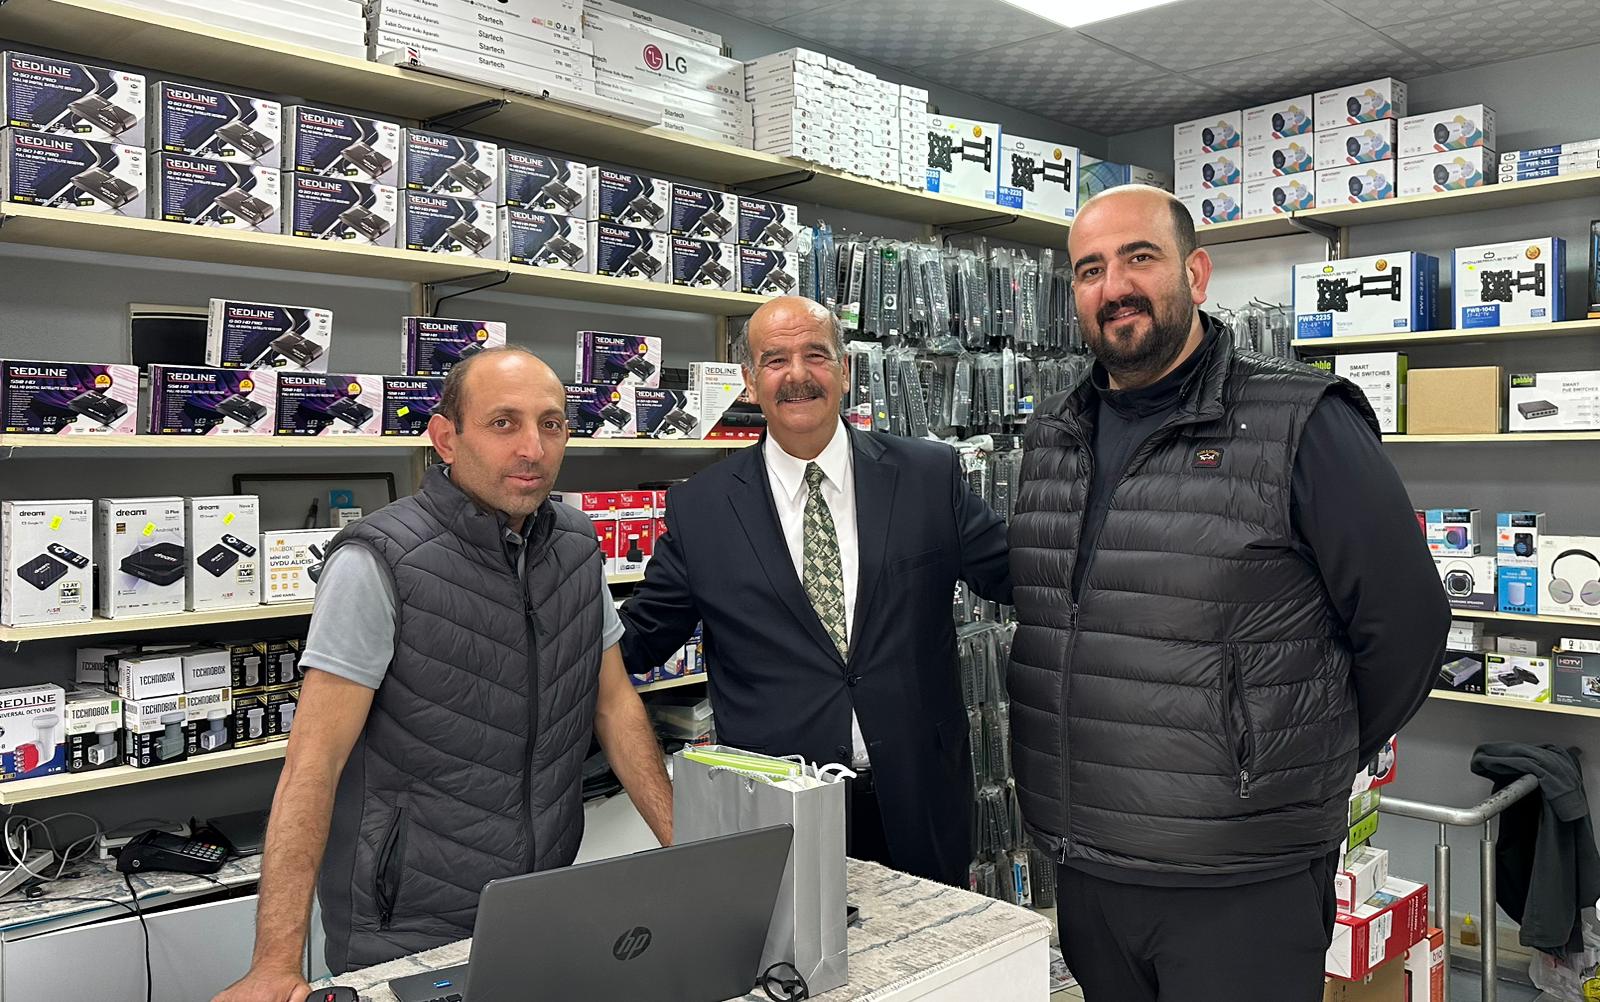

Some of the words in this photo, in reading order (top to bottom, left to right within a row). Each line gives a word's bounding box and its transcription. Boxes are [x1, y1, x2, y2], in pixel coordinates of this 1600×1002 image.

[478, 13, 504, 26] Startech
[632, 11, 653, 23] Startech
[479, 30, 504, 43] Startech
[479, 43, 505, 55] Startech
[12, 59, 71, 78] REDLINE
[479, 56, 505, 69] Startech
[665, 53, 688, 74] LG
[166, 88, 218, 106] REDLINE
[664, 108, 685, 119] Startech
[301, 113, 344, 129] REDLINE
[664, 121, 685, 132] Startech
[15, 134, 73, 152] REDLINE
[410, 133, 448, 148] REDLINE
[166, 158, 217, 175] REDLINE
[509, 153, 543, 168] REDLINE
[601, 171, 632, 183] REDLINE
[298, 179, 342, 193] REDLINE
[675, 189, 703, 200] REDLINE
[409, 194, 448, 208] REDLINE
[511, 210, 545, 223] REDLINE
[600, 226, 631, 238] REDLINE
[674, 238, 702, 250] REDLINE
[229, 307, 274, 321] REDLINE
[1466, 306, 1496, 314] PWR-1042
[1298, 313, 1332, 323] PWR-2235
[1322, 320, 1331, 328] TV
[420, 322, 459, 333] REDLINE
[595, 336, 625, 346] REDLINE
[10, 367, 67, 379] REDLINE
[704, 366, 737, 377] REDLINE
[1362, 369, 1393, 377] SWITCHES
[167, 372, 216, 384] REDLINE
[280, 376, 327, 387] REDLINE
[386, 381, 428, 391] REDLINE
[635, 390, 666, 399] REDLINE
[116, 509, 145, 517] dream
[1560, 658, 1582, 666] HDTV
[193, 664, 227, 679] TECHNOBOX
[140, 672, 176, 687] TECHNOBOX
[0, 694, 57, 709] REDLINE
[187, 694, 221, 708] TECHNOBOX
[26, 709, 41, 718] OCTO
[72, 705, 110, 720] TECHNOBOX
[142, 701, 178, 715] TECHNOBOX
[616, 927, 651, 960] hp
